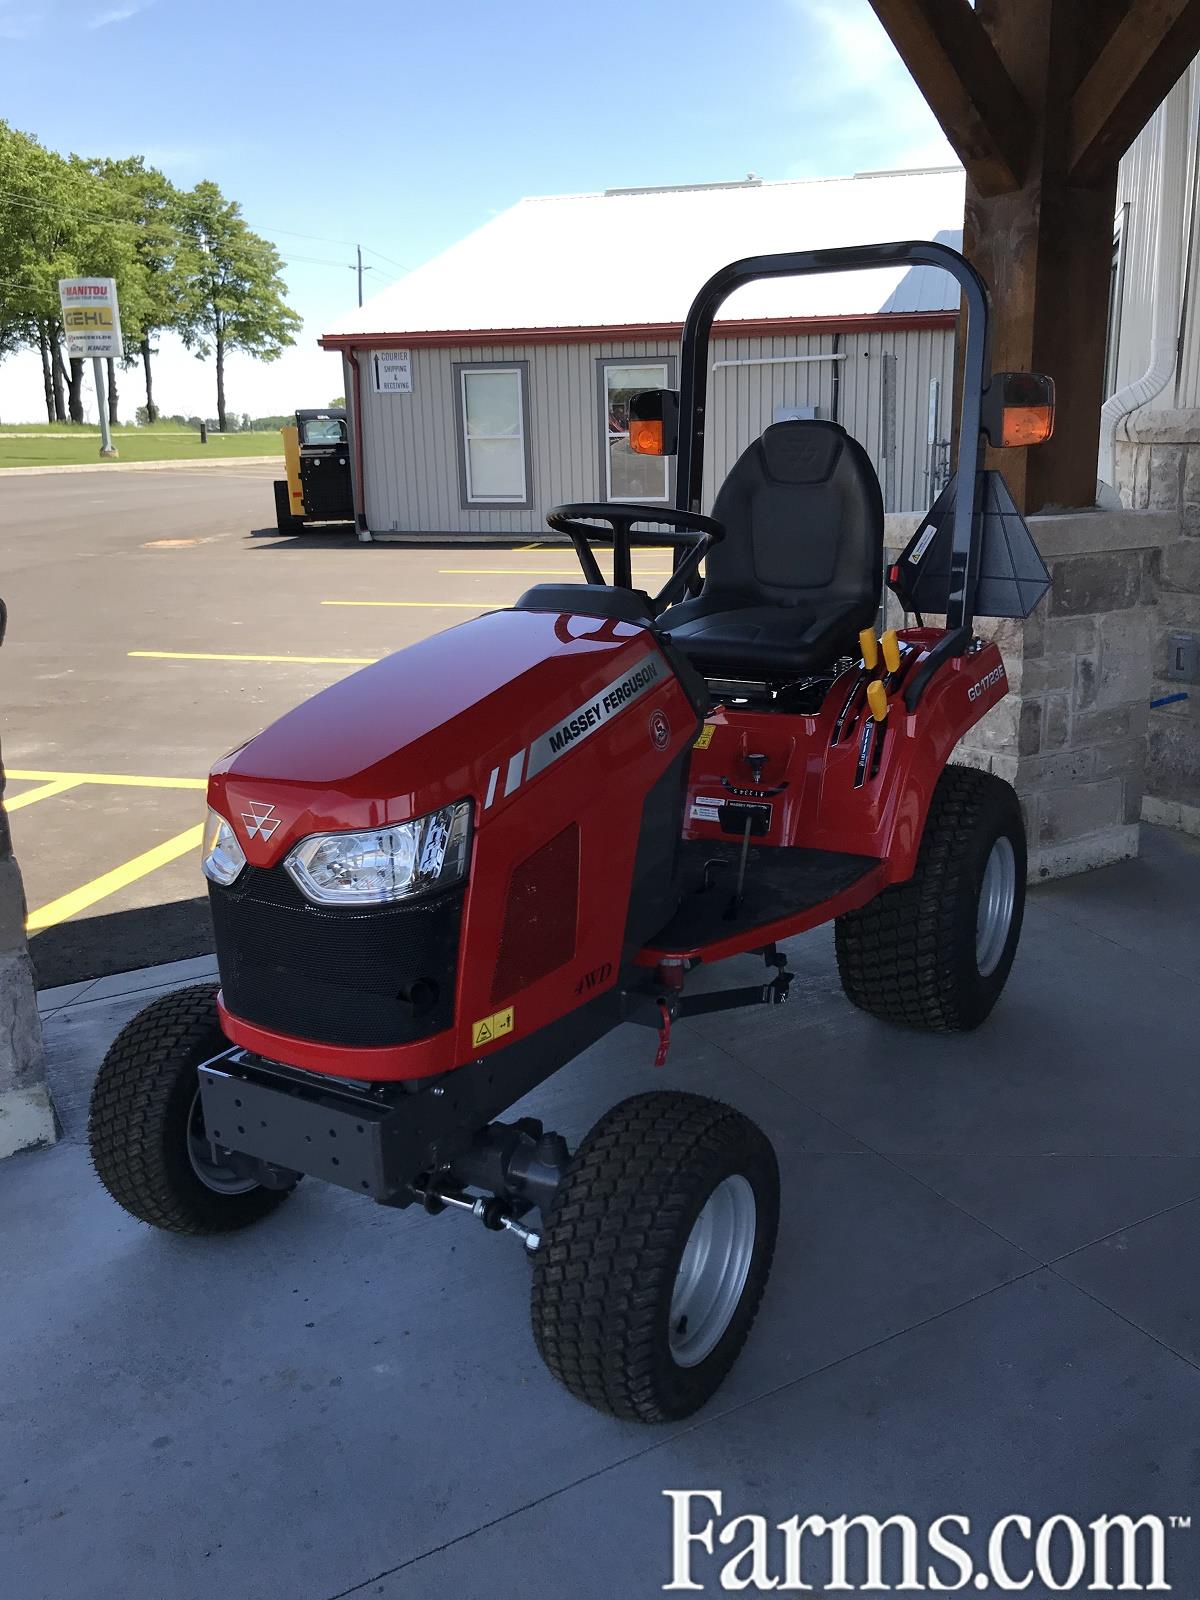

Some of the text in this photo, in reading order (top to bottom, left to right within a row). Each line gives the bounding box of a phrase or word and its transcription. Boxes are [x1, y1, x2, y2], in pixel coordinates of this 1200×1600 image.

[66, 286, 107, 296] MANITOU
[65, 312, 112, 326] GEHL
[381, 352, 408, 361] COURIER
[383, 365, 407, 373] SHIPPING
[967, 664, 1005, 702] GC1723E
[548, 662, 658, 753] MASSEY FERGUSON
[574, 963, 612, 994] 4WD
